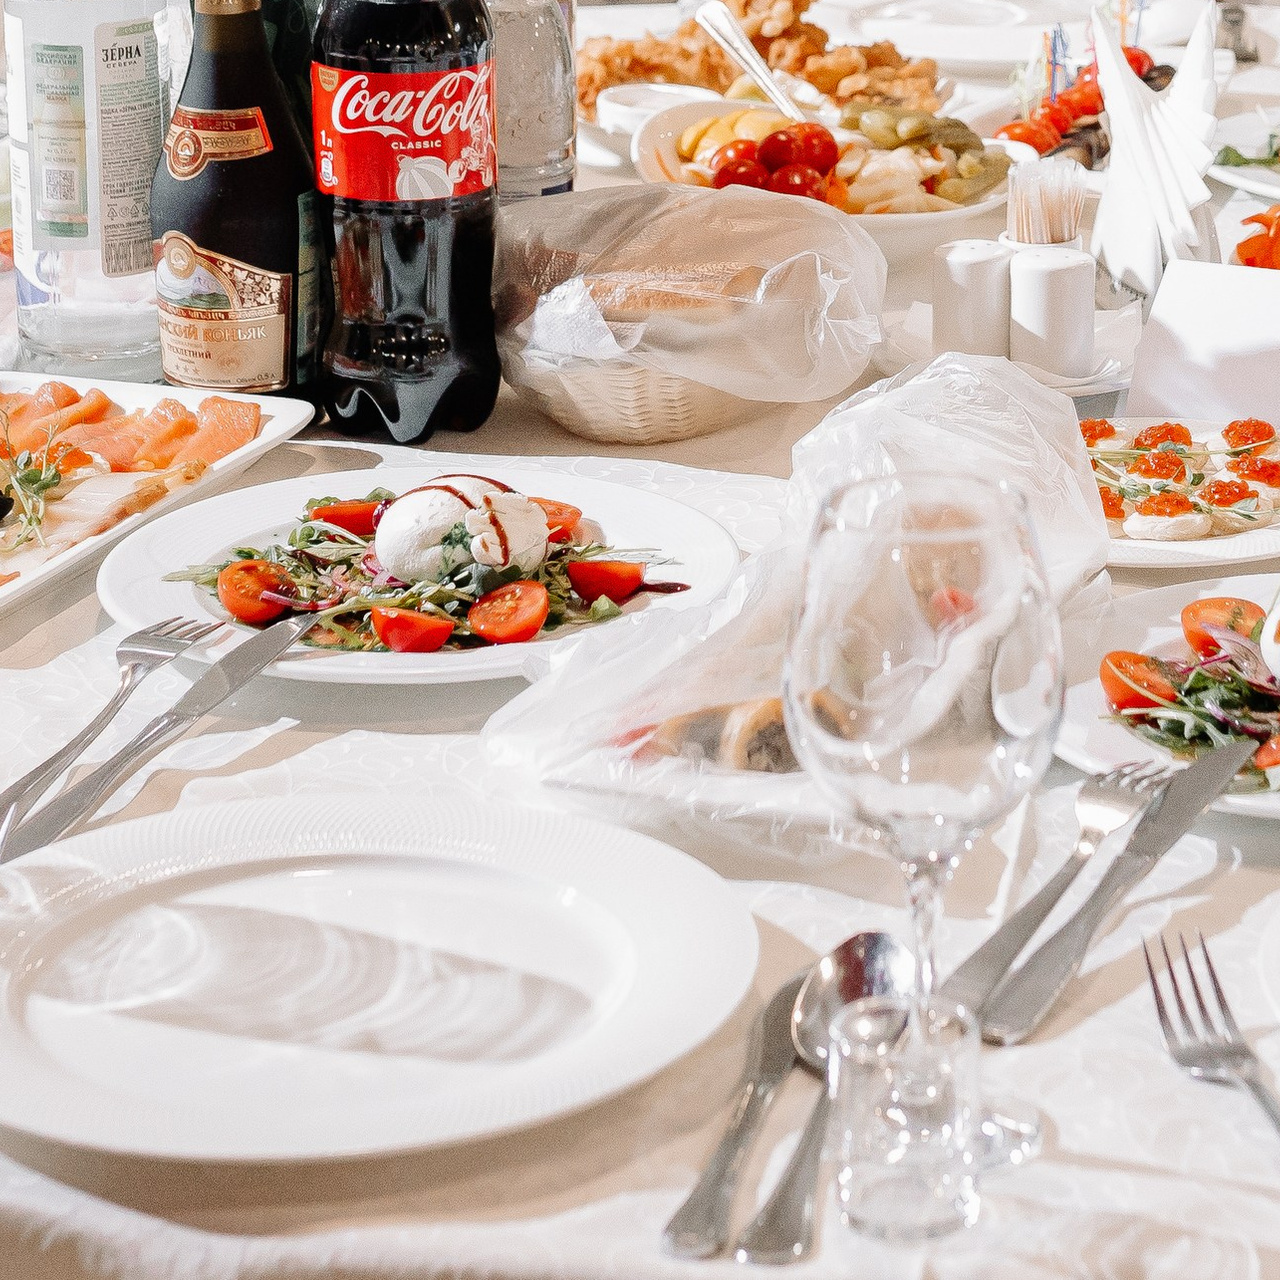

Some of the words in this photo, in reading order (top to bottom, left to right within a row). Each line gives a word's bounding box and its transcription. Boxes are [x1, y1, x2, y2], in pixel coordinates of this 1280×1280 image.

[332, 65, 492, 138] Coca-Cola
[391, 139, 442, 150] CLASSIC
[202, 324, 267, 343] КОНЬЯК
